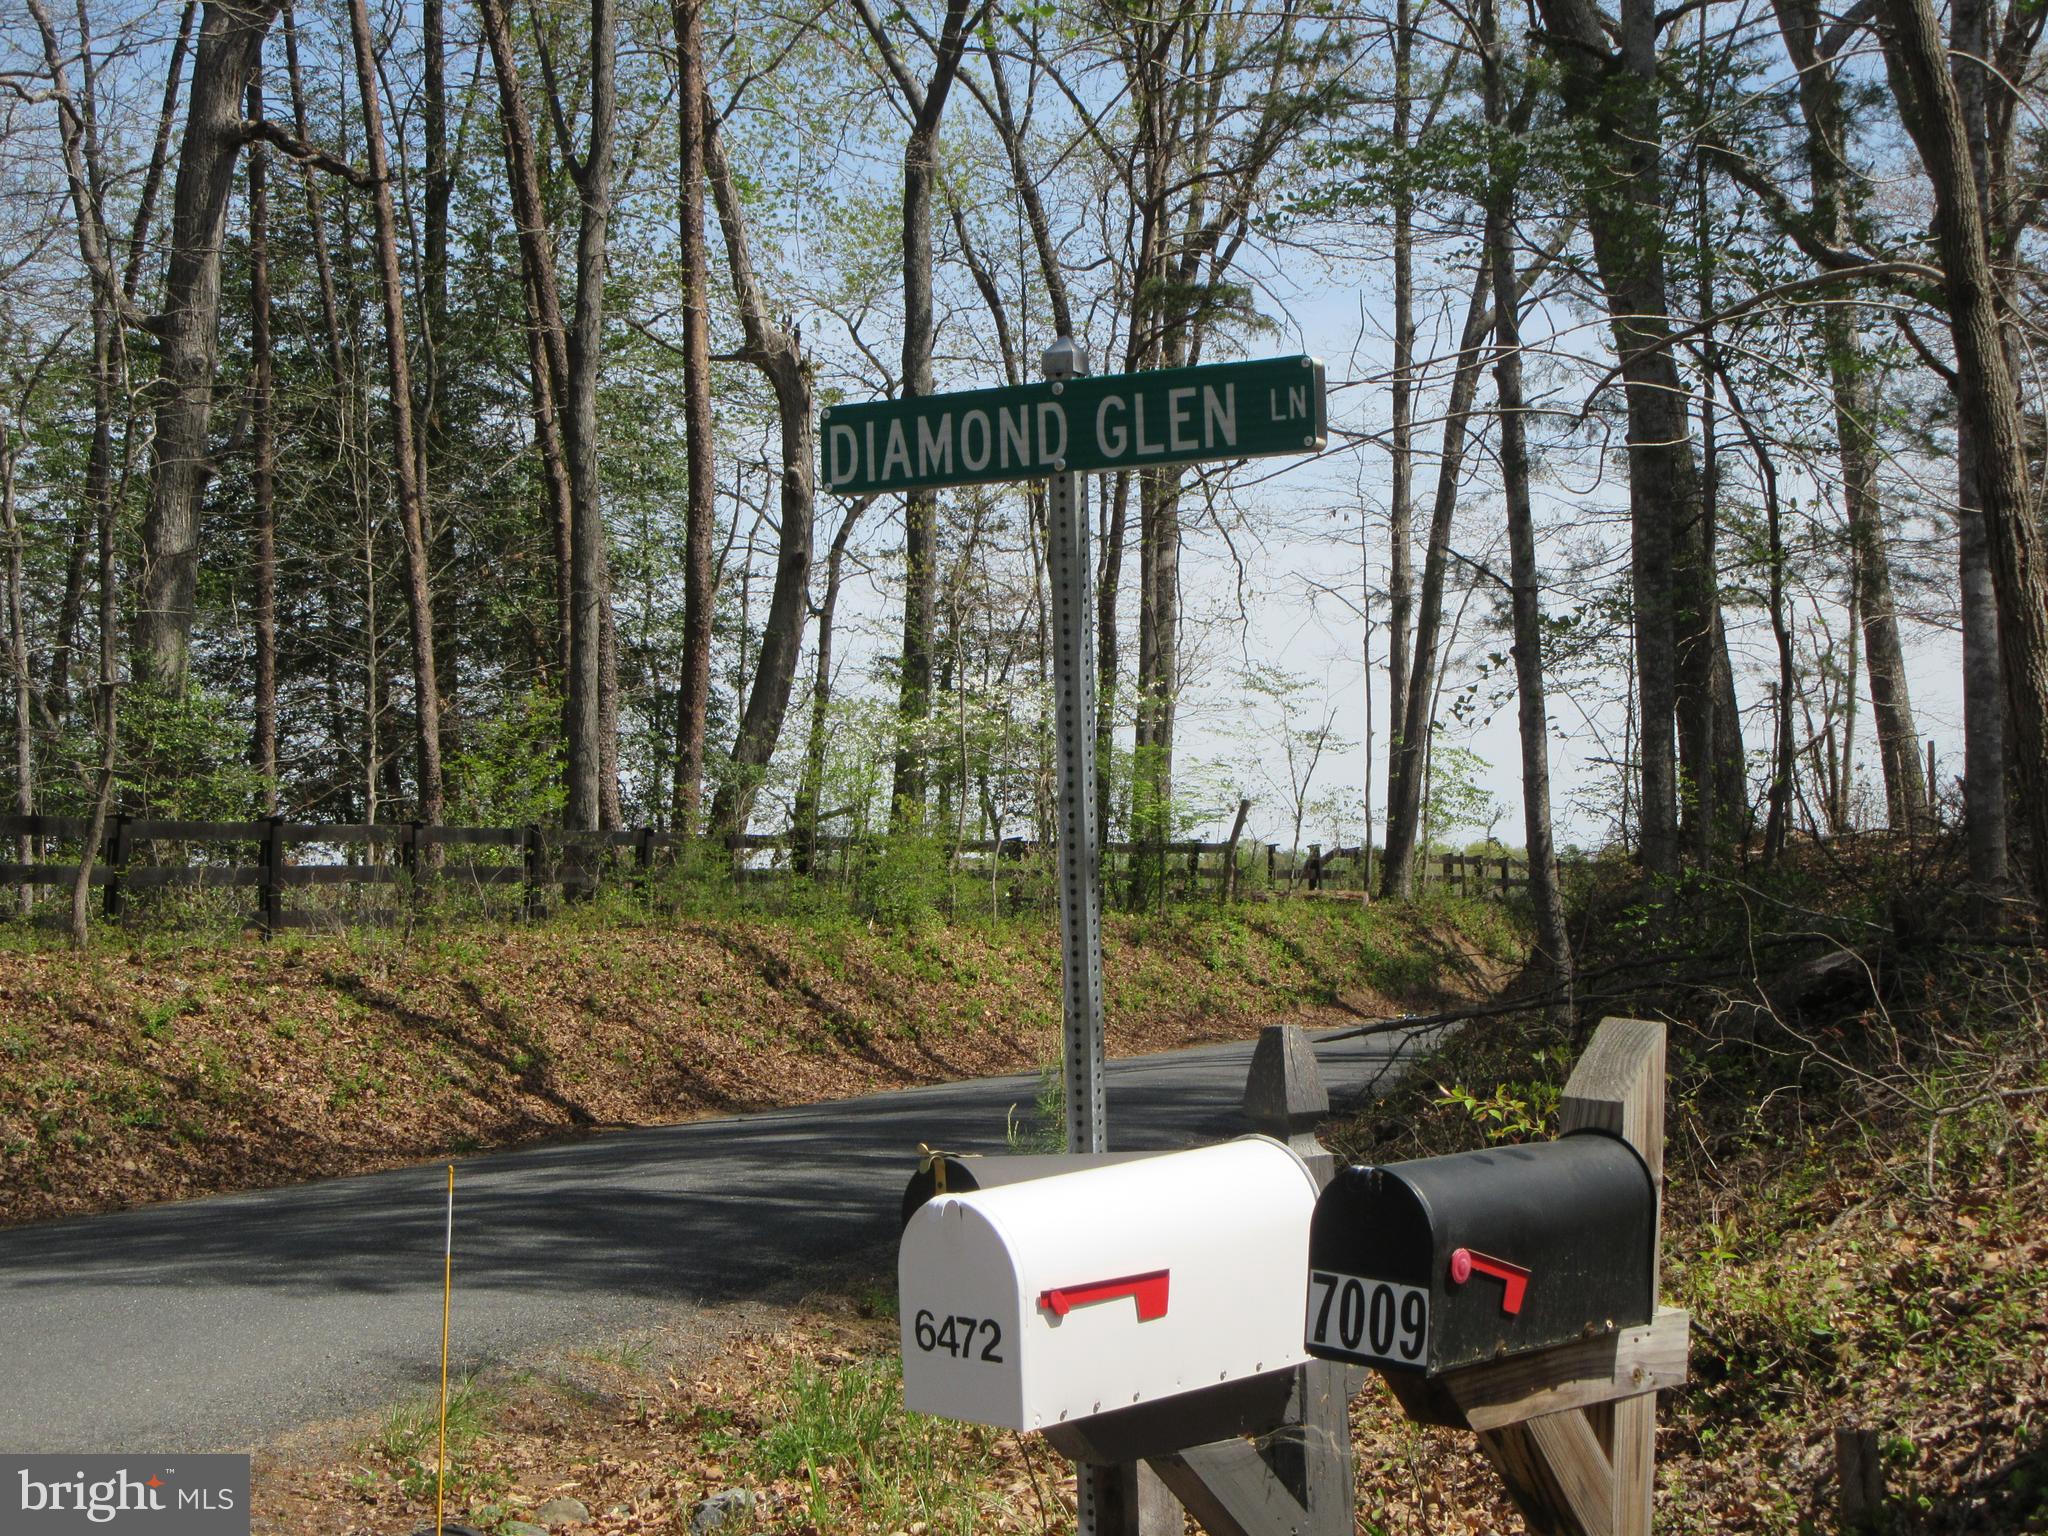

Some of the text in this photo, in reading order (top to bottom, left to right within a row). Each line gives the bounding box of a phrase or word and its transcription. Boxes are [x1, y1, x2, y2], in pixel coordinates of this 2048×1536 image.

[830, 383, 1306, 485] DIAMOND GLEN LN
[915, 1309, 1003, 1363] 6472
[1312, 1273, 1427, 1360] 7009
